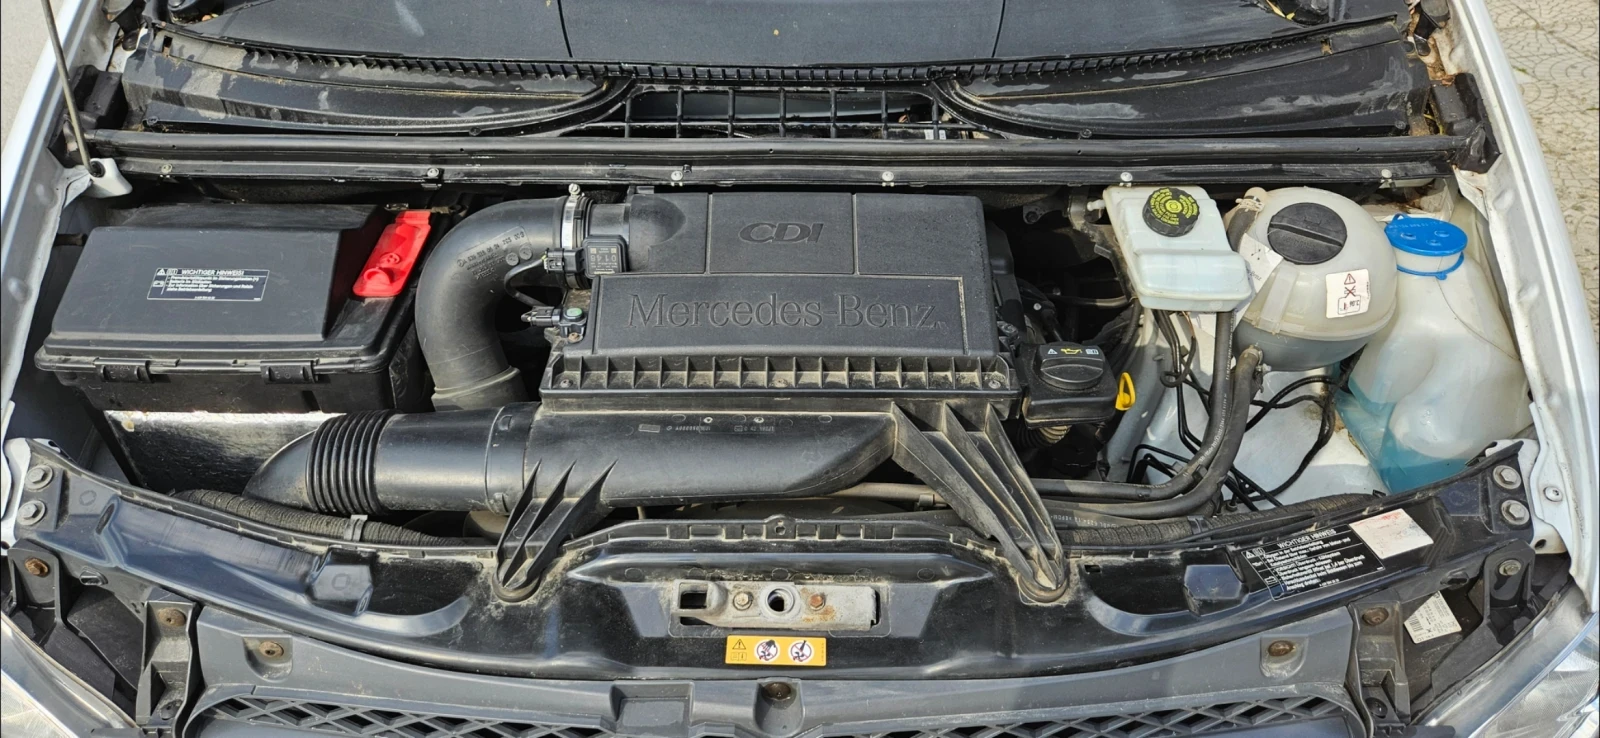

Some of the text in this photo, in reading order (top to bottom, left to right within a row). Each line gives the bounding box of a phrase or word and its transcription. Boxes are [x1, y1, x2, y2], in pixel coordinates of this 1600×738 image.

[739, 222, 824, 243] CDI
[628, 292, 937, 328] Mercedes-Benz
[1277, 536, 1311, 549] WICHTIGER
